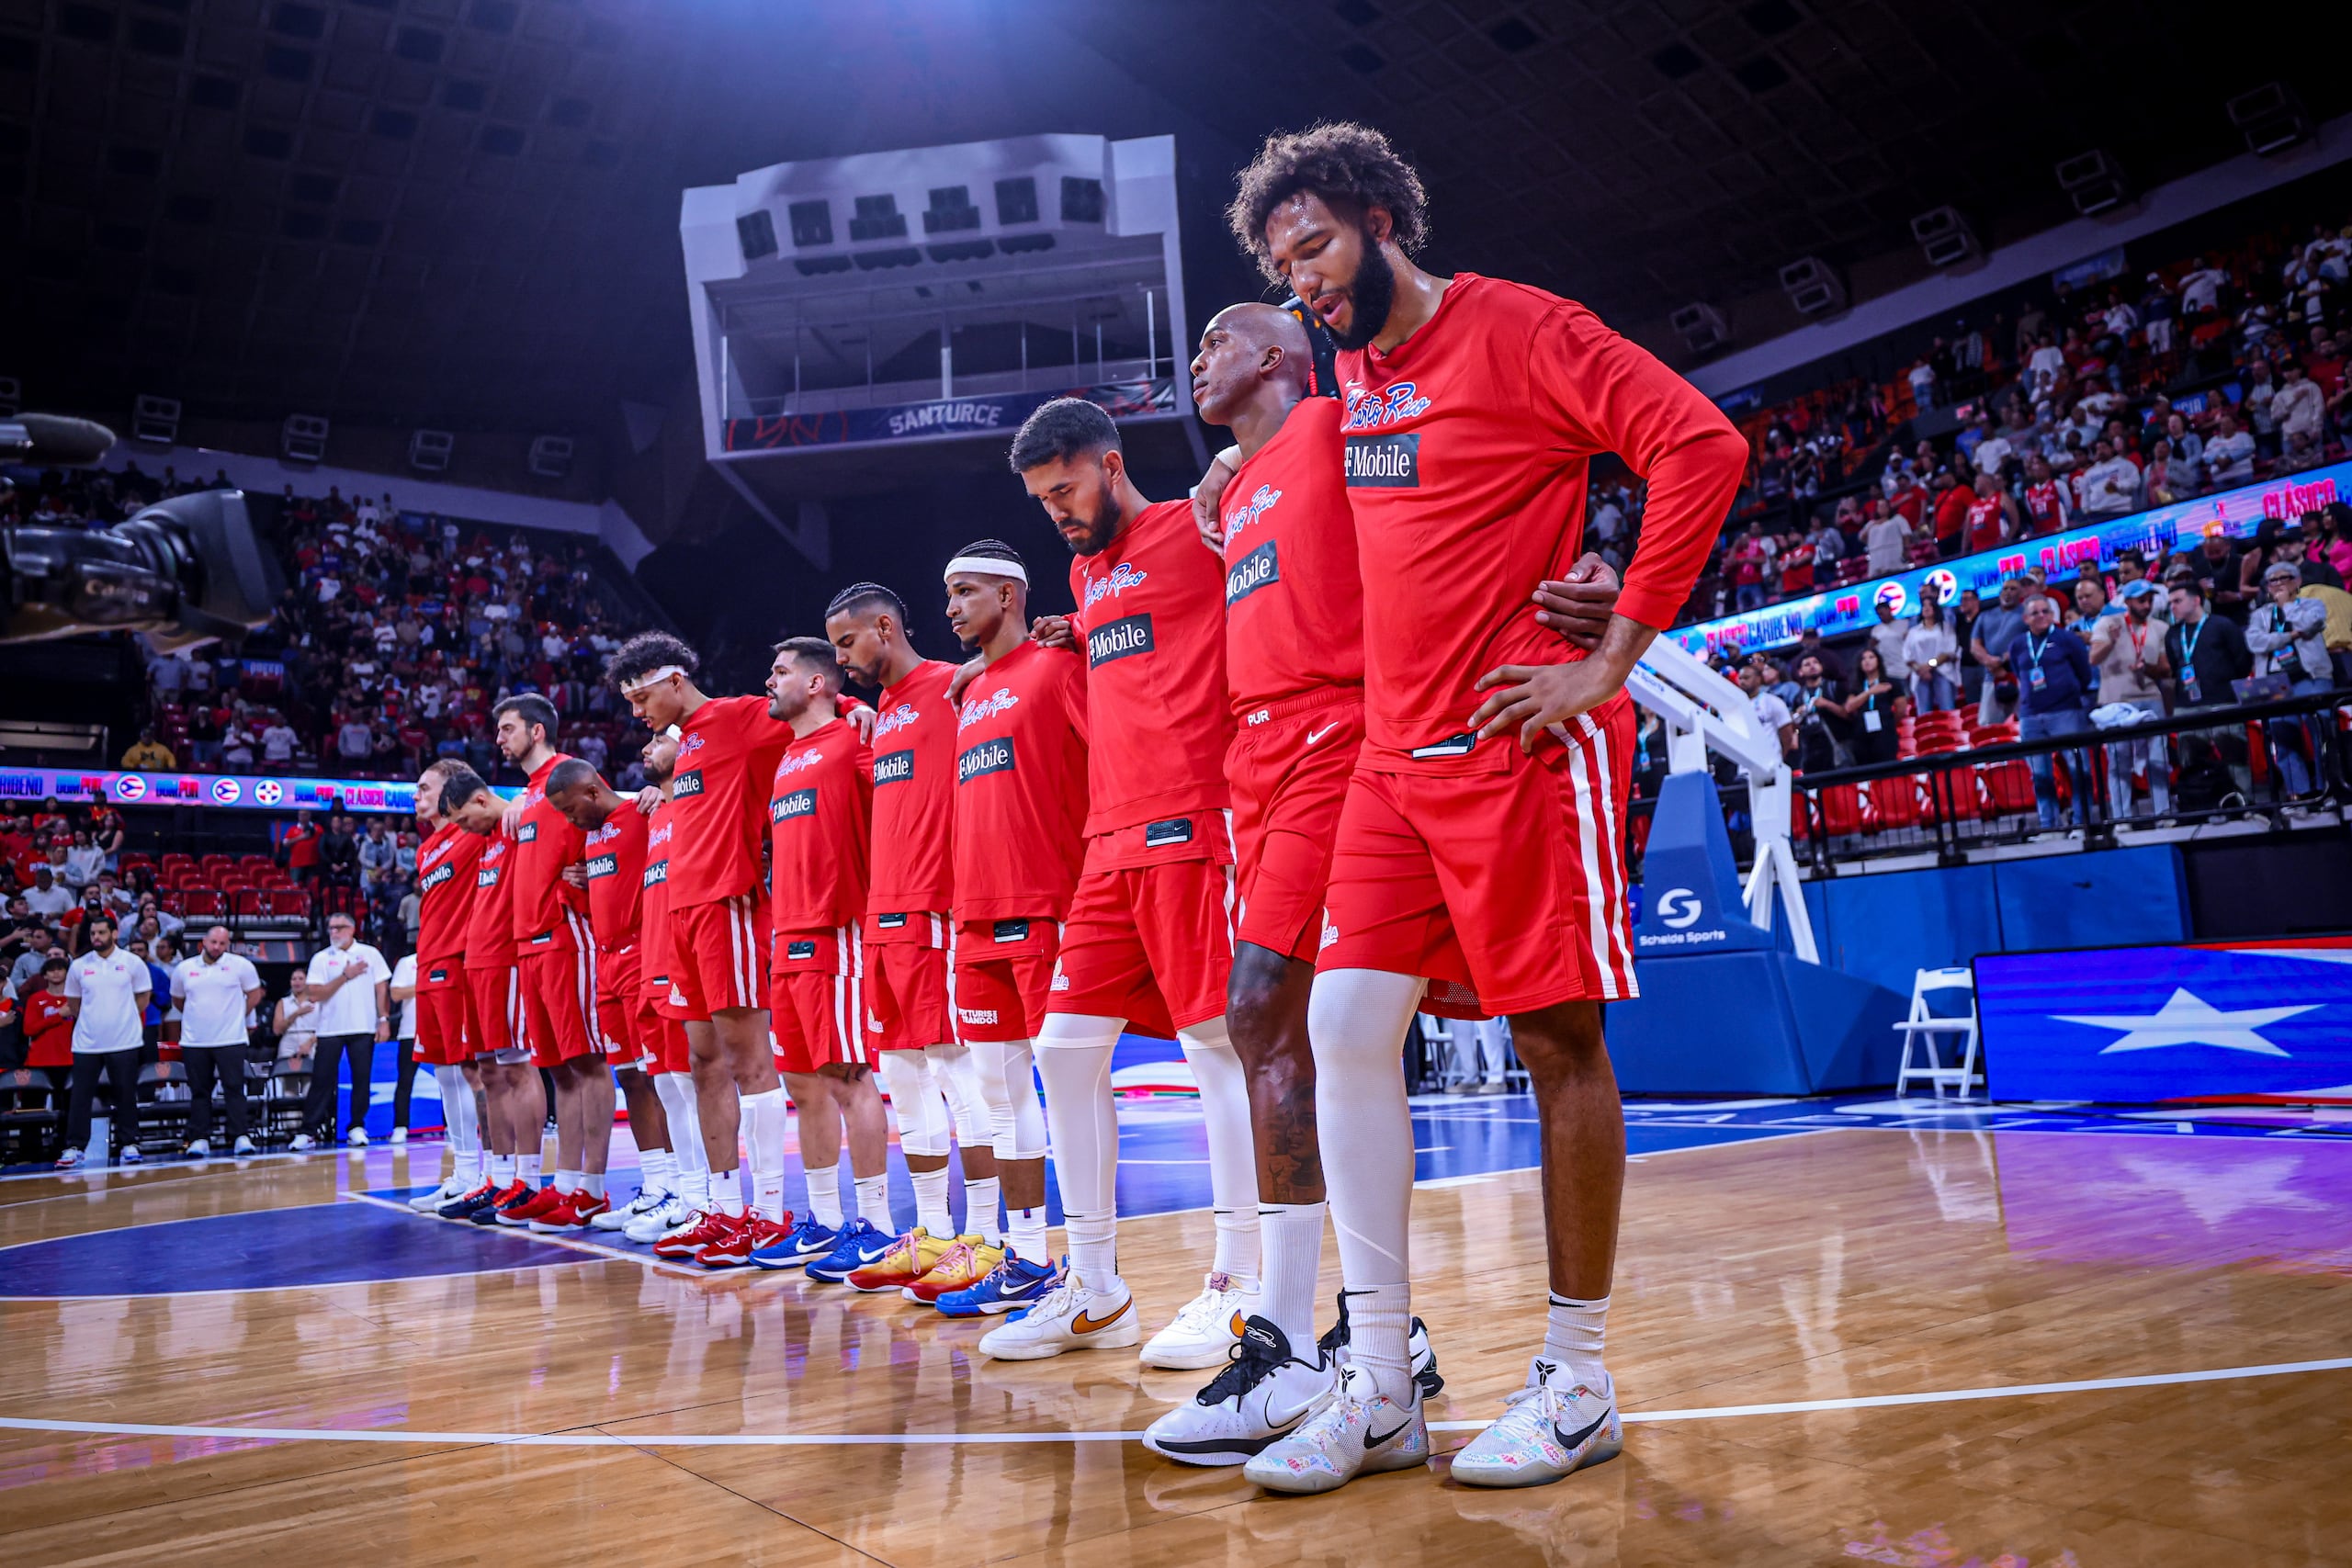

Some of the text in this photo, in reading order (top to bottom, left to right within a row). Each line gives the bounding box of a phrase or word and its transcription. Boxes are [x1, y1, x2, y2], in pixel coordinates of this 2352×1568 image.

[889, 403, 1003, 435] SANTURCE
[1384, 381, 1431, 425] Rico
[1247, 484, 1283, 525] Rico
[1107, 562, 1148, 598] Rico
[1248, 709, 1271, 727] PUR
[1685, 930, 1726, 944] Sports
